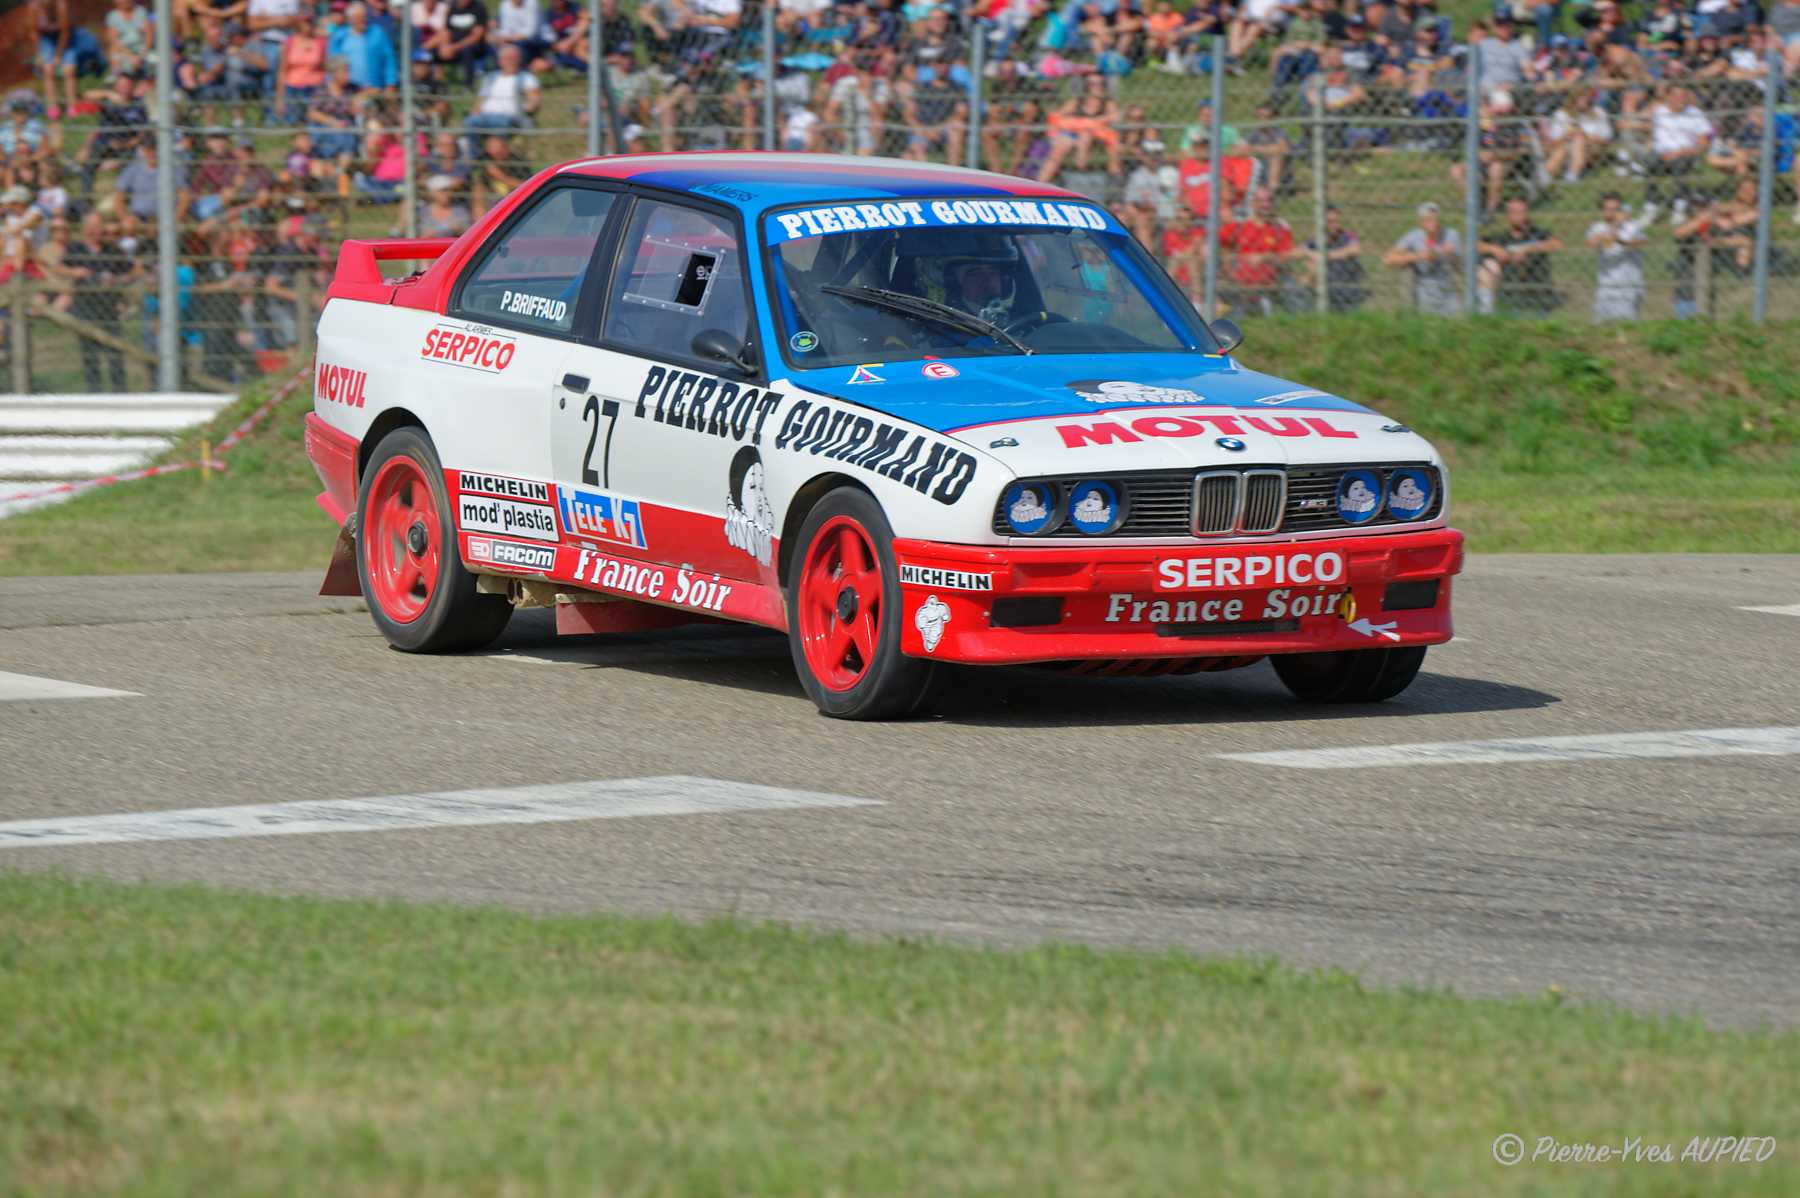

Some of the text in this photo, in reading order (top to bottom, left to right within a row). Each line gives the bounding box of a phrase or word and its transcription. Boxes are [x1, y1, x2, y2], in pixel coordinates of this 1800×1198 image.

[777, 200, 1107, 239] PIERROT GOURMAND
[500, 290, 567, 321] P.BRIFFAUD
[422, 328, 516, 371] SERPICO
[318, 362, 367, 409] MOTUL
[583, 395, 620, 489] 27
[634, 365, 977, 506] PIERROT GOURMAND
[1055, 415, 1358, 449] MOTUL
[461, 474, 547, 500] MICHELIN
[463, 502, 554, 532] mod' plastia
[561, 484, 638, 547] TELE K7
[494, 545, 553, 567] FACOM
[1159, 552, 1342, 588] SERPICO
[574, 549, 732, 612] France Soir
[902, 566, 990, 590] MICHELIN
[1105, 586, 1341, 622] France Soir
